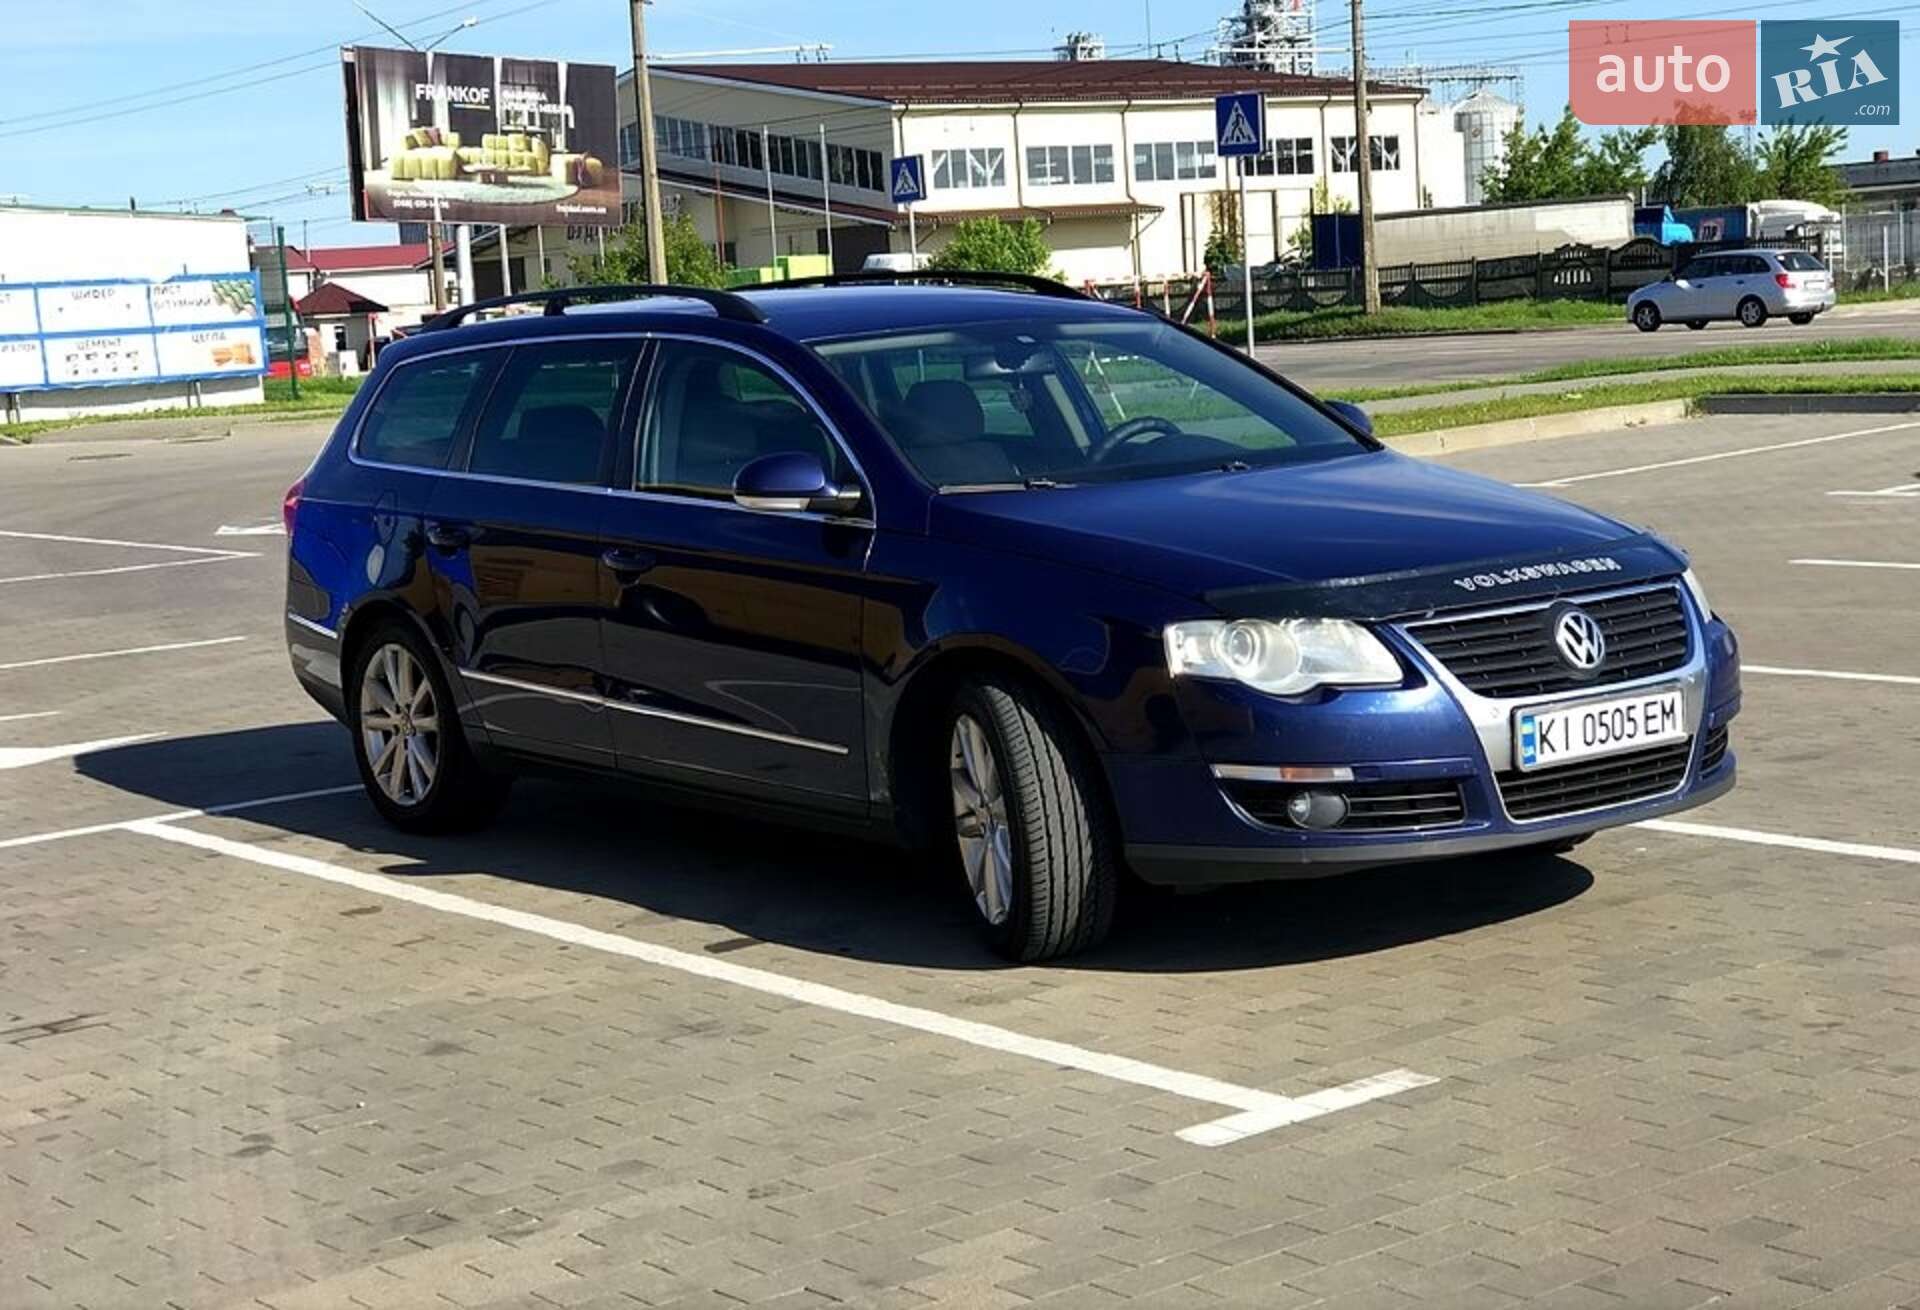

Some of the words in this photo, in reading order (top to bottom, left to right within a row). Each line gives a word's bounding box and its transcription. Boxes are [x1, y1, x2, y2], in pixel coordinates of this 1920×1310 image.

[415, 84, 490, 104] FRANKOF
[1453, 557, 1622, 591] VOLKSWAGEN
[1538, 717, 1569, 754] KI
[1583, 706, 1638, 746] 0505
[1644, 697, 1677, 736] EM
